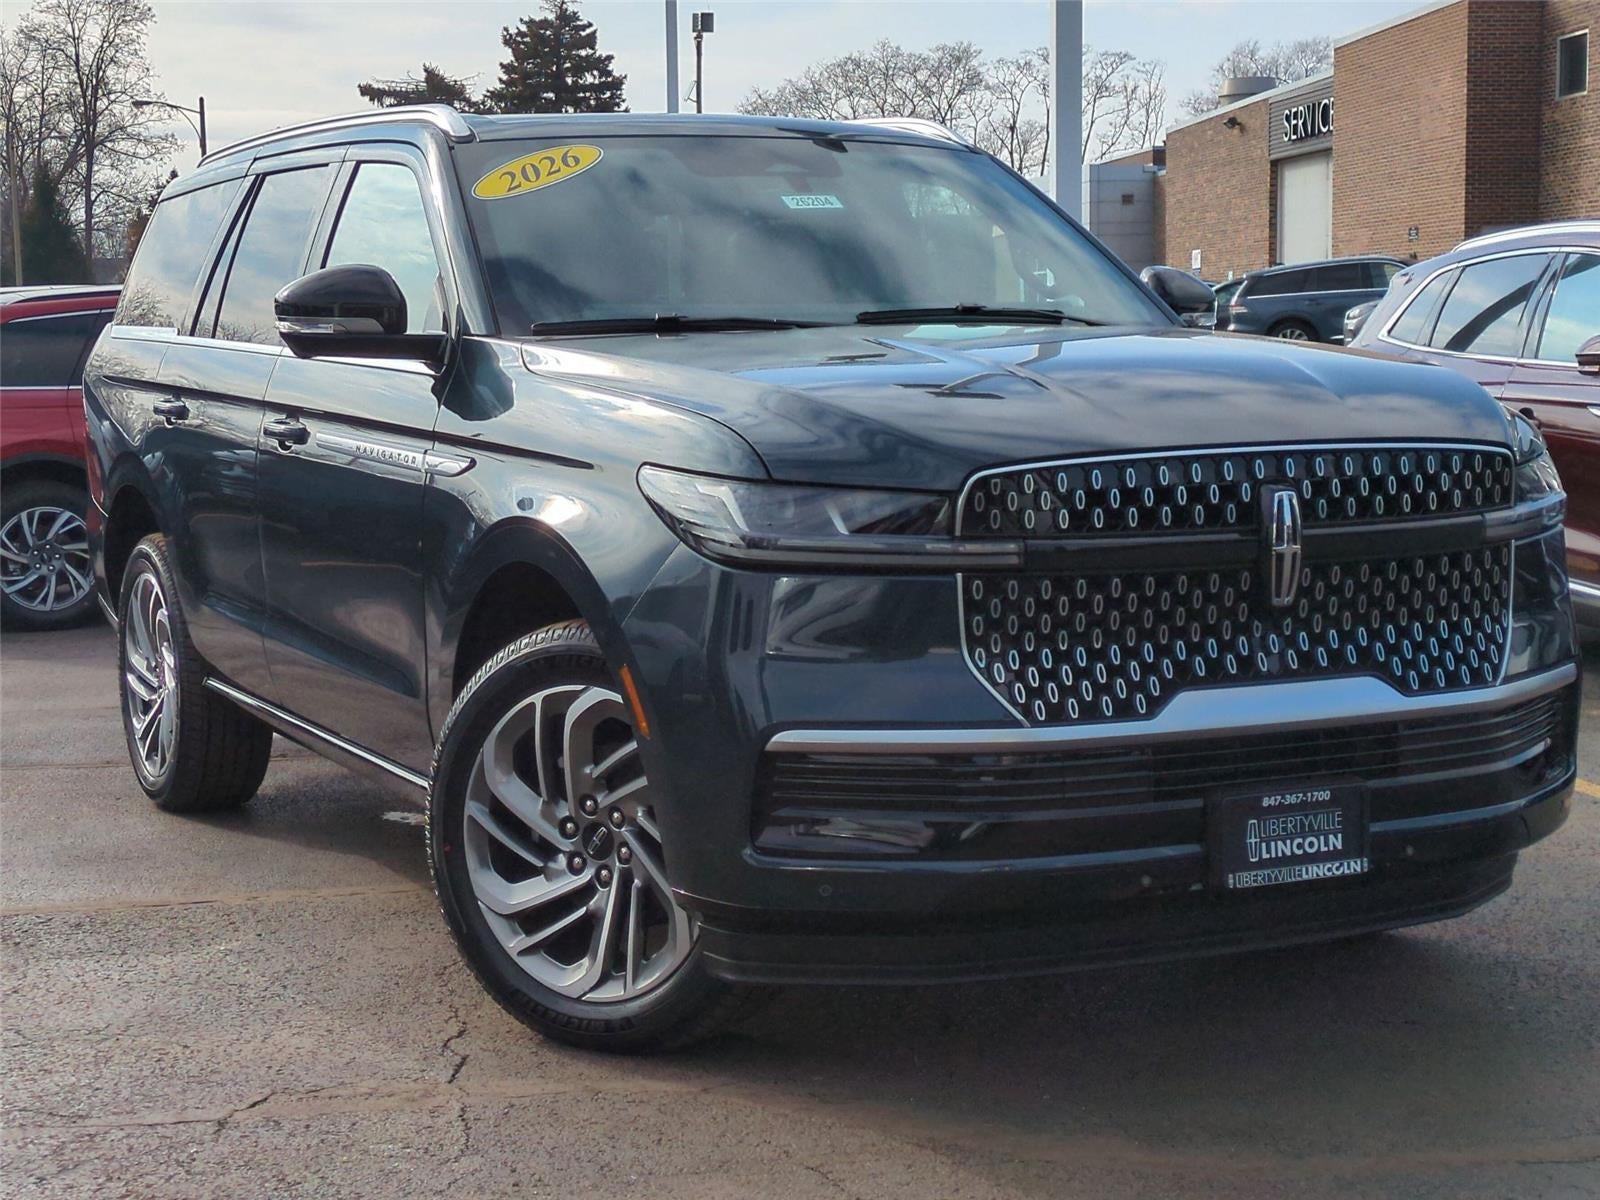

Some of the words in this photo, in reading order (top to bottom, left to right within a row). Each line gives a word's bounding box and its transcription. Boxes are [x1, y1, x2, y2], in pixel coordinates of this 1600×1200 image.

[499, 148, 581, 192] 2026
[791, 196, 834, 207] 26204
[355, 445, 417, 465] NAVIGATOR
[1262, 790, 1331, 807] 847-367-1700
[1260, 811, 1343, 838] LIBERTYVILLE
[1262, 833, 1343, 859] LINCOLN
